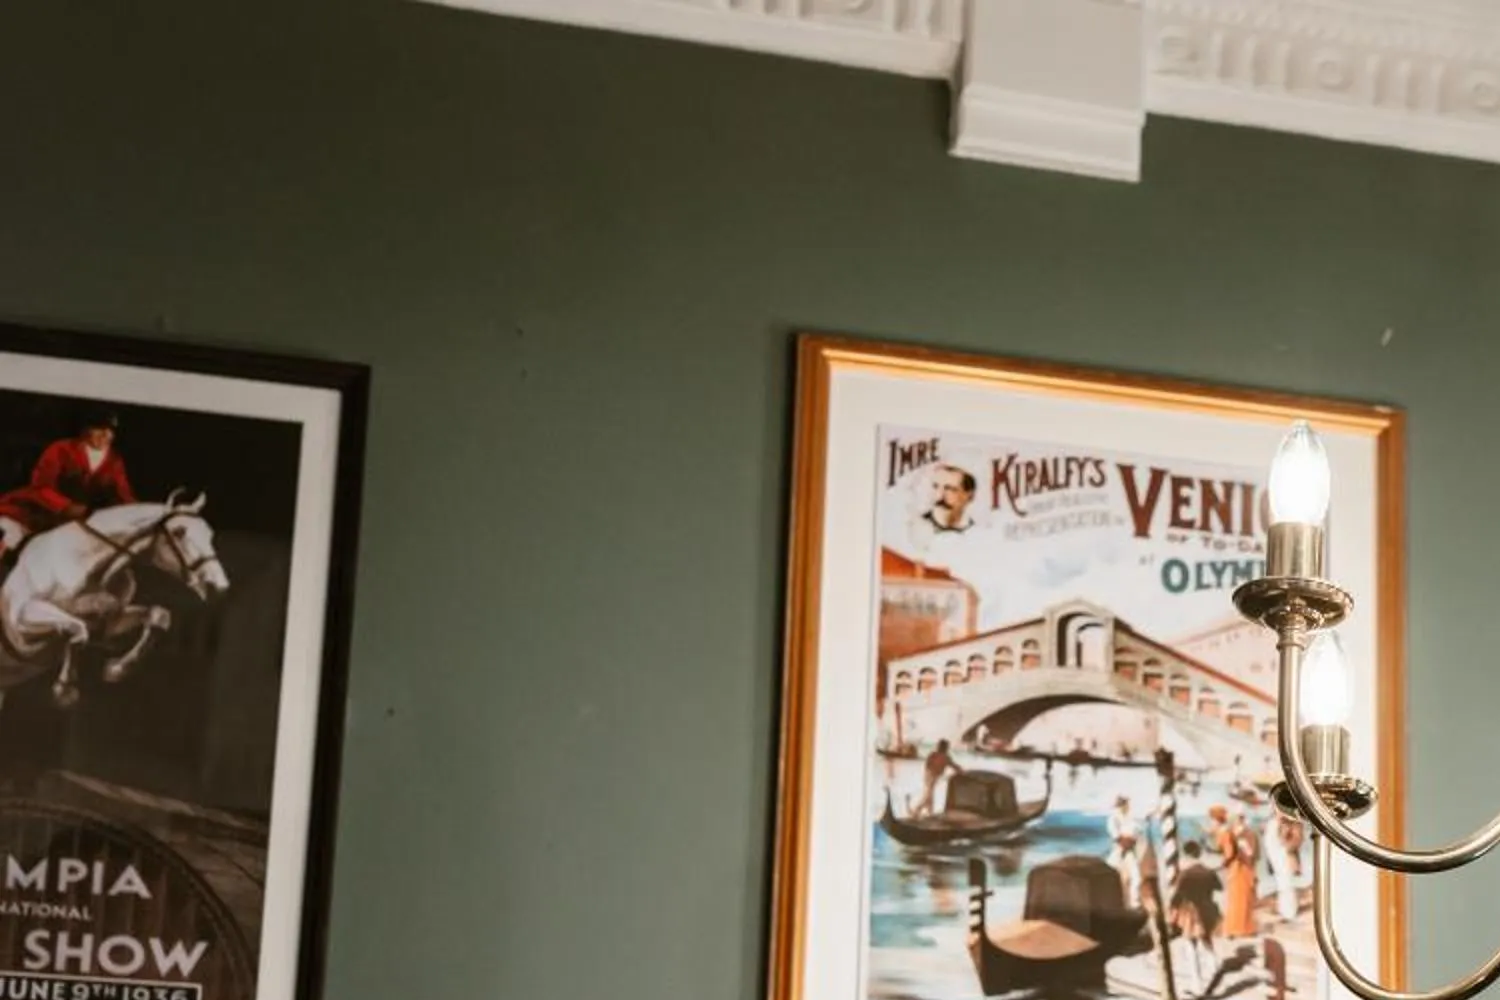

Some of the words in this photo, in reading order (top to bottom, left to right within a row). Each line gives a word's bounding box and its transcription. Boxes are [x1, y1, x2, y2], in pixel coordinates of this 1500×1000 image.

[887, 438, 940, 487] IMRE
[1115, 463, 1268, 538] VENI
[1201, 535, 1264, 554] TO-DA
[1161, 557, 1265, 594] OLYM
[5, 854, 152, 899] MPIA
[23, 929, 209, 977] SHOW
